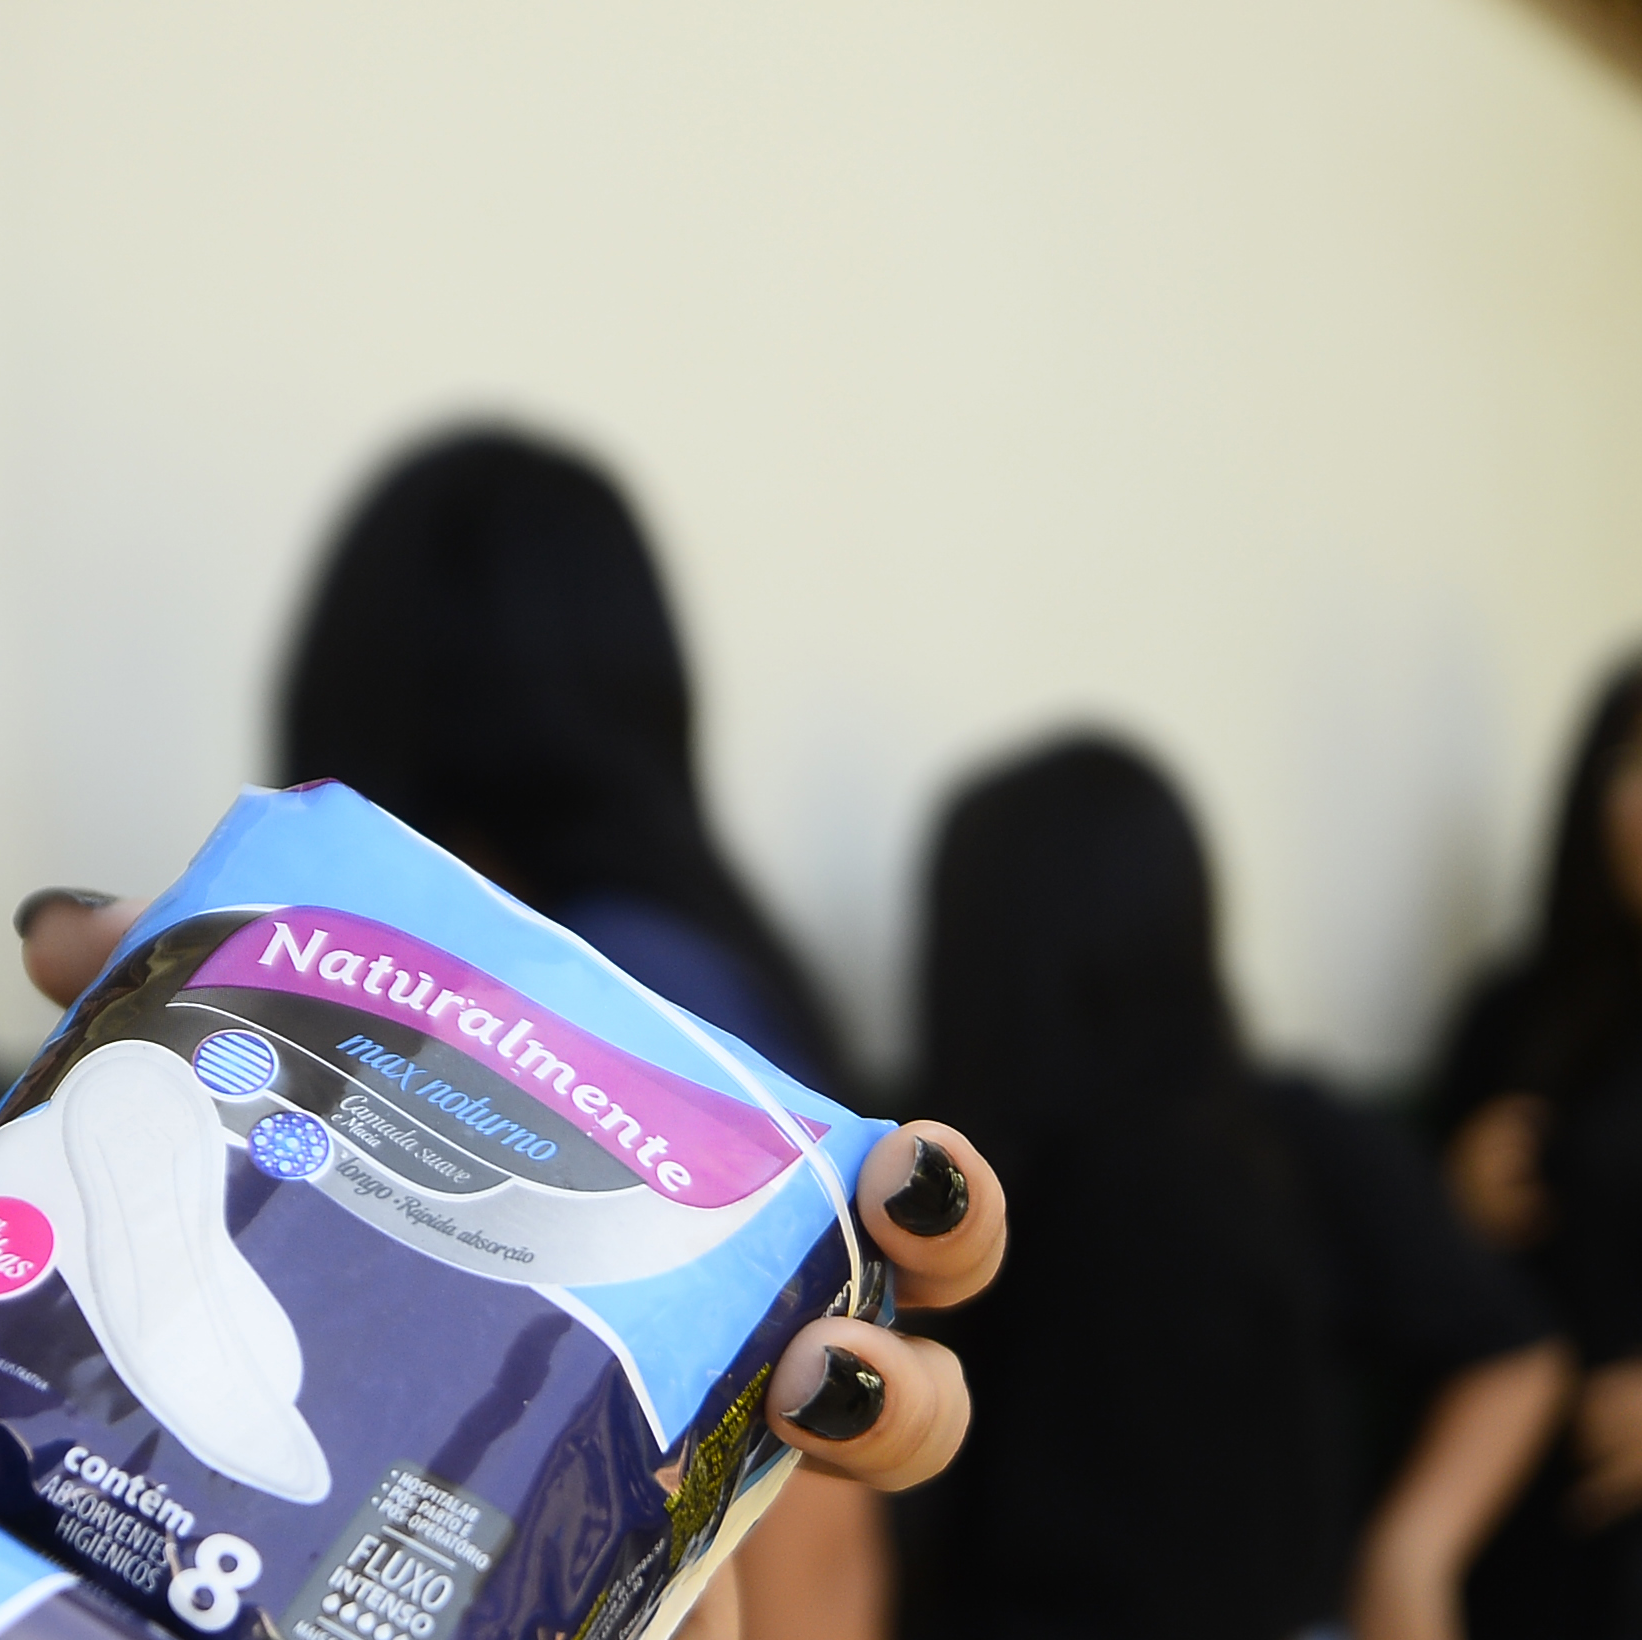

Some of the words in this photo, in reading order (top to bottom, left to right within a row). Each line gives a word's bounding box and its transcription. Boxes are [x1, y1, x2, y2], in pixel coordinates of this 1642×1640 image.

[258, 921, 693, 1193] Naturalmente
[336, 1033, 427, 1092] max
[415, 1078, 560, 1162] noturno
[340, 1094, 419, 1152] Camada
[414, 1147, 471, 1184] suave
[456, 1230, 536, 1265] absorção
[63, 1446, 196, 1538] contém
[398, 1471, 481, 1523] HOSPITALAR
[39, 1475, 169, 1568] ABSORVENTES
[167, 1532, 263, 1634] 8
[347, 1533, 455, 1615] FLUXO
[327, 1564, 436, 1640] INTENSO
